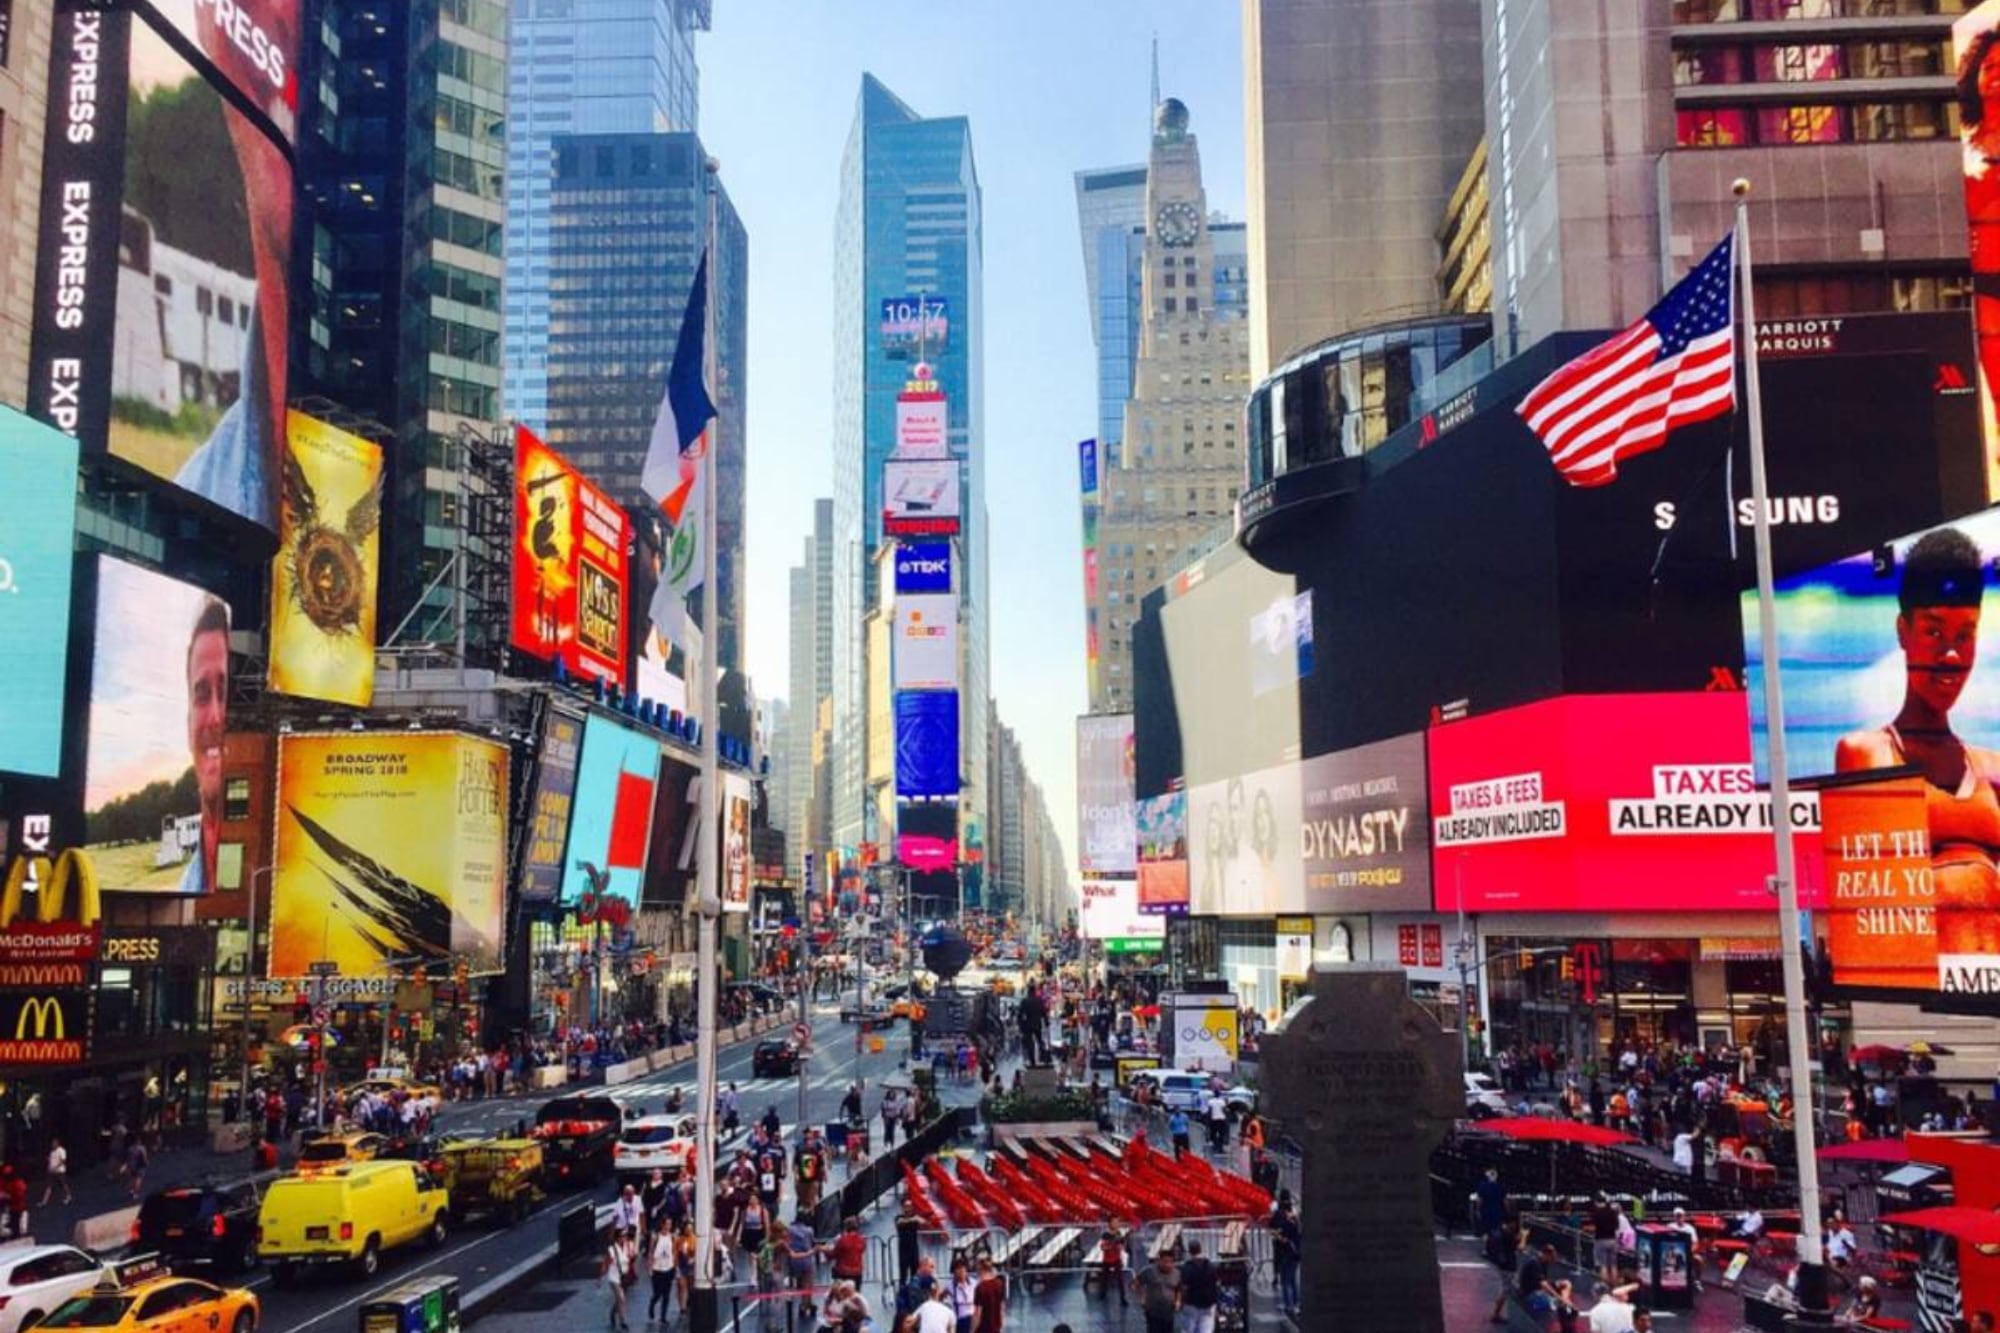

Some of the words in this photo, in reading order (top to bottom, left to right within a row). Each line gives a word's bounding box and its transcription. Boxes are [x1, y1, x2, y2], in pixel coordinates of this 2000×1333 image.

[198, 0, 284, 88] RESS
[56, 182, 90, 329] EXPRESS
[884, 303, 945, 322] 10:57
[1653, 495, 1840, 531] SSUNG
[911, 559, 948, 574] TDK
[323, 764, 374, 775] SPRING
[326, 753, 407, 764] BROADWAY
[1453, 784, 1491, 810] TAXES
[1506, 777, 1539, 803] FEES
[1659, 769, 1755, 794] TAXES
[1439, 815, 1491, 841] ALREADY
[1493, 808, 1561, 836] INCLUDED
[1618, 803, 1751, 829] ALREADY
[1301, 807, 1408, 859] DYNASTY
[1841, 832, 1883, 861] LET
[1083, 885, 1116, 897] What
[1836, 869, 1897, 899] REAL
[0, 933, 93, 948] McDonald's
